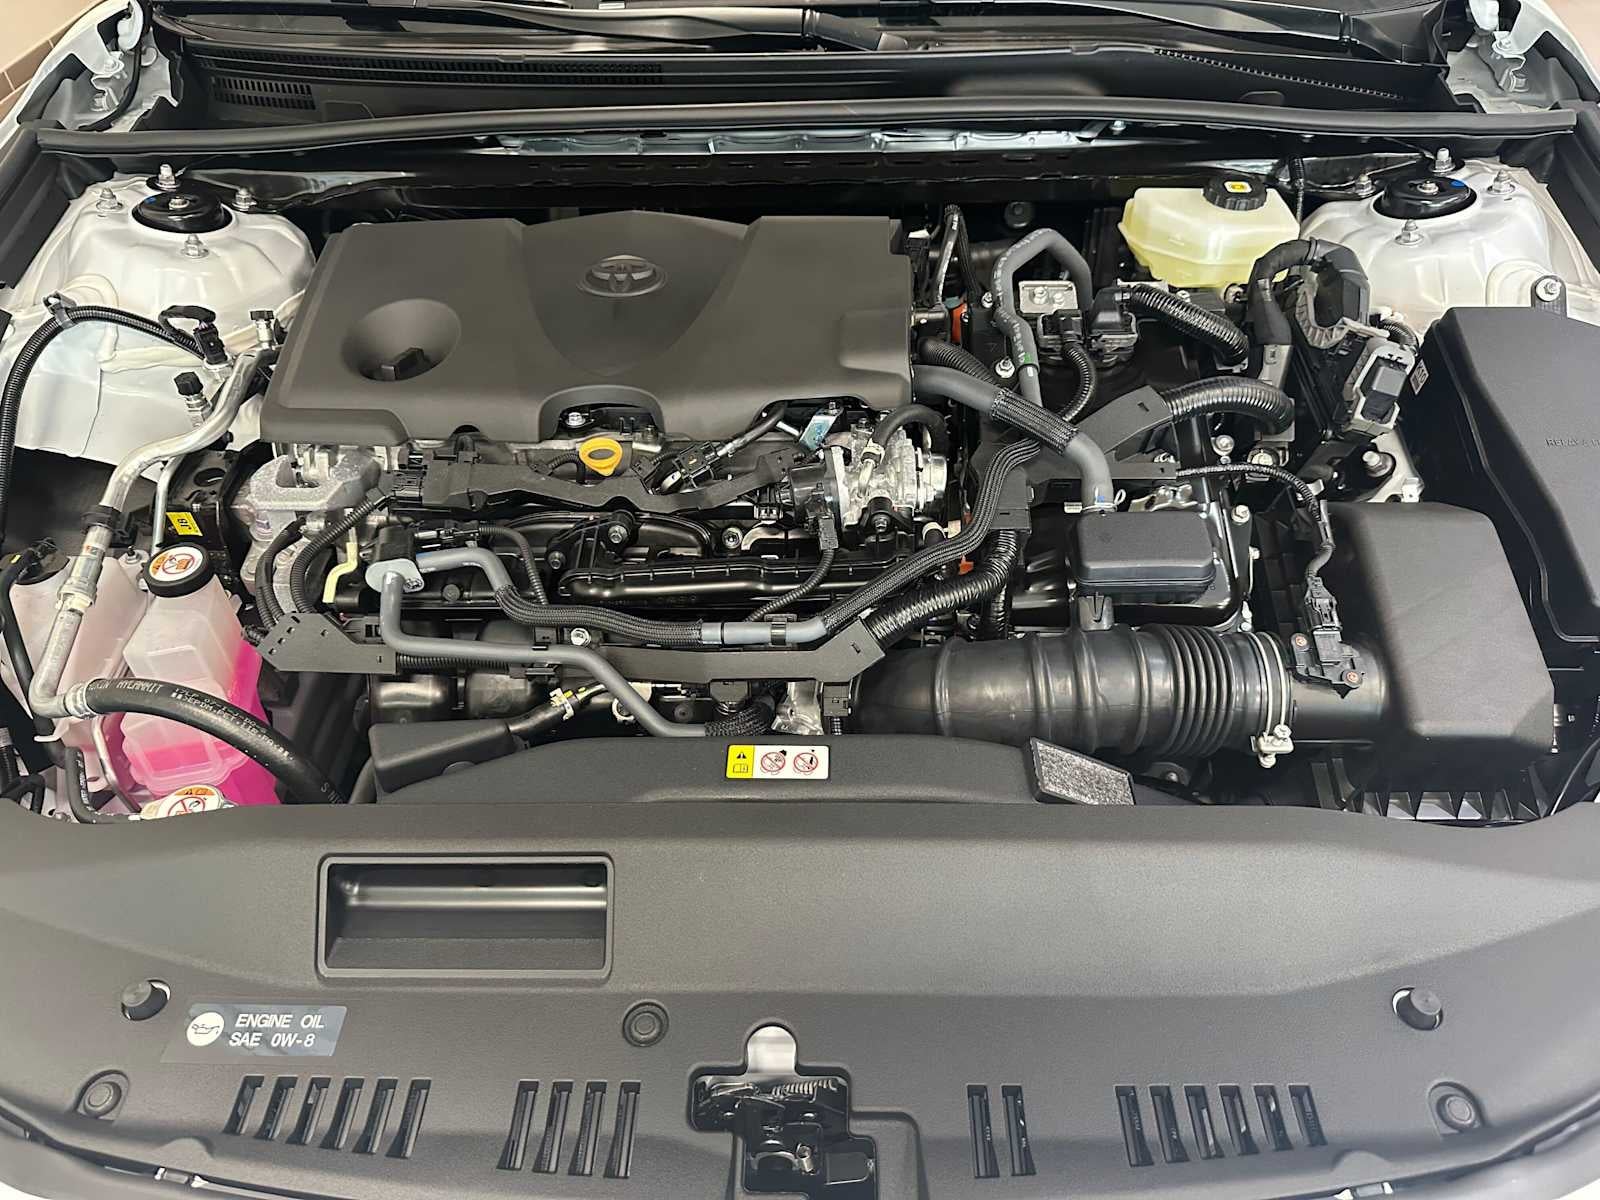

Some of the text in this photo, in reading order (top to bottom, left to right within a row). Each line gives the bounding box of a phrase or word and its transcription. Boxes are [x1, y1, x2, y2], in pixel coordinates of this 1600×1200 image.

[235, 1013, 325, 1029] ENGINE OIL
[229, 1031, 316, 1047] SAE 0W-8
